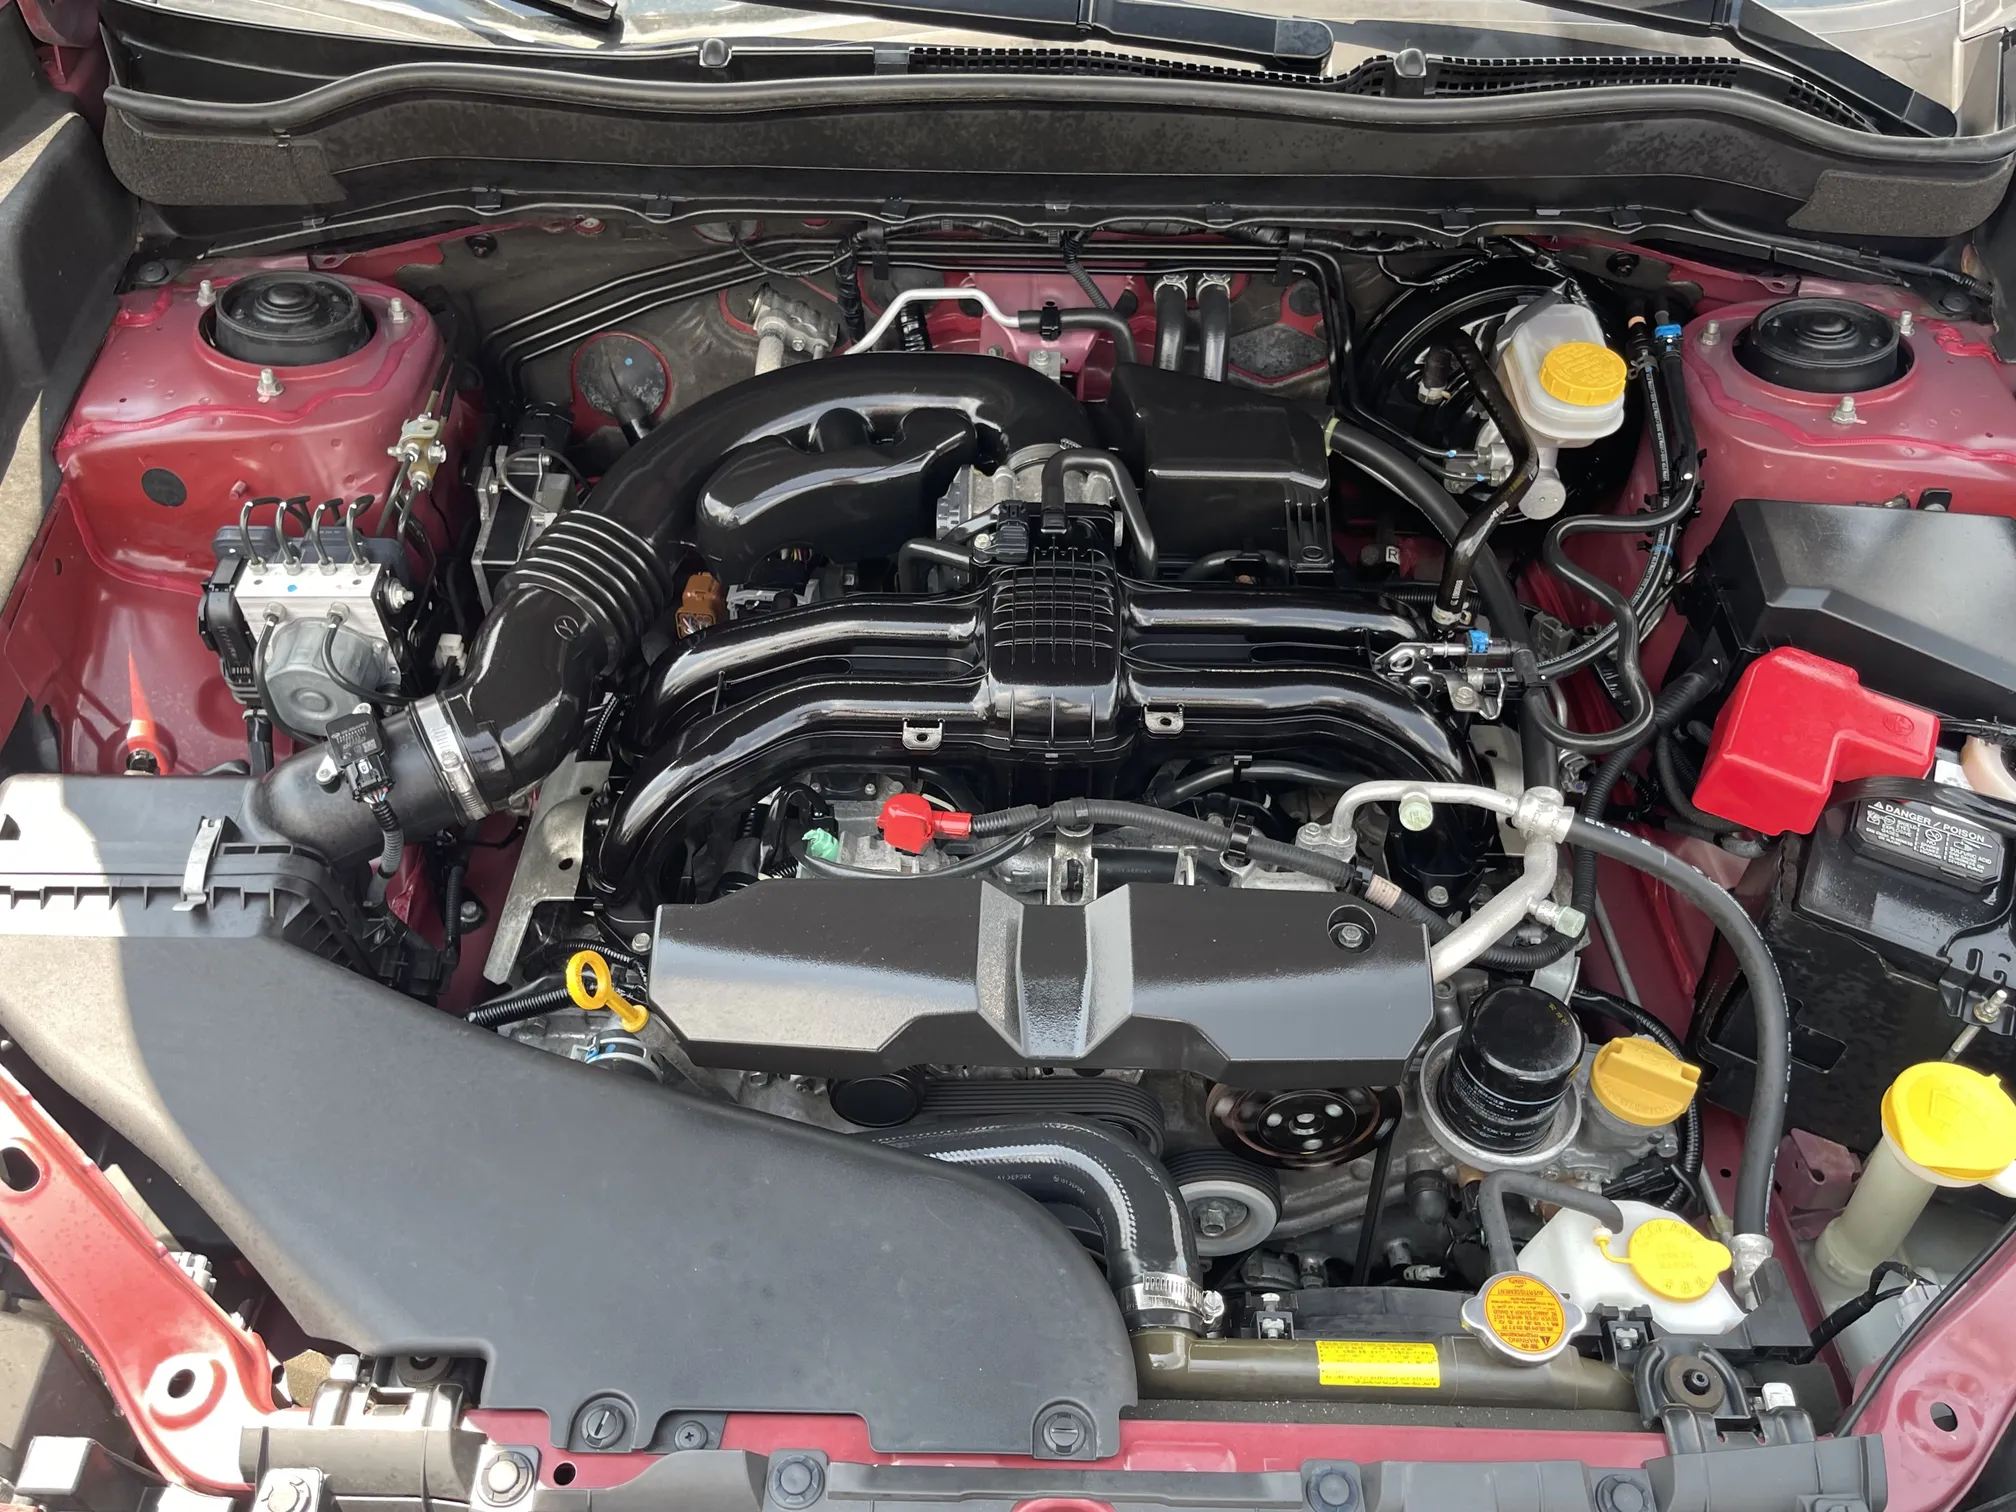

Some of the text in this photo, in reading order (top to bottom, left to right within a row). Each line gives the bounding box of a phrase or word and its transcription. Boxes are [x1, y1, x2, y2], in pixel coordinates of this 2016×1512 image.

[1388, 549, 1398, 560] R
[1584, 816, 1631, 838] EK 10
[1885, 804, 1931, 825] DANGER
[1943, 823, 1985, 843] POISON
[1978, 856, 1992, 865] ACID
[1481, 1124, 1512, 1137] TOKYO
